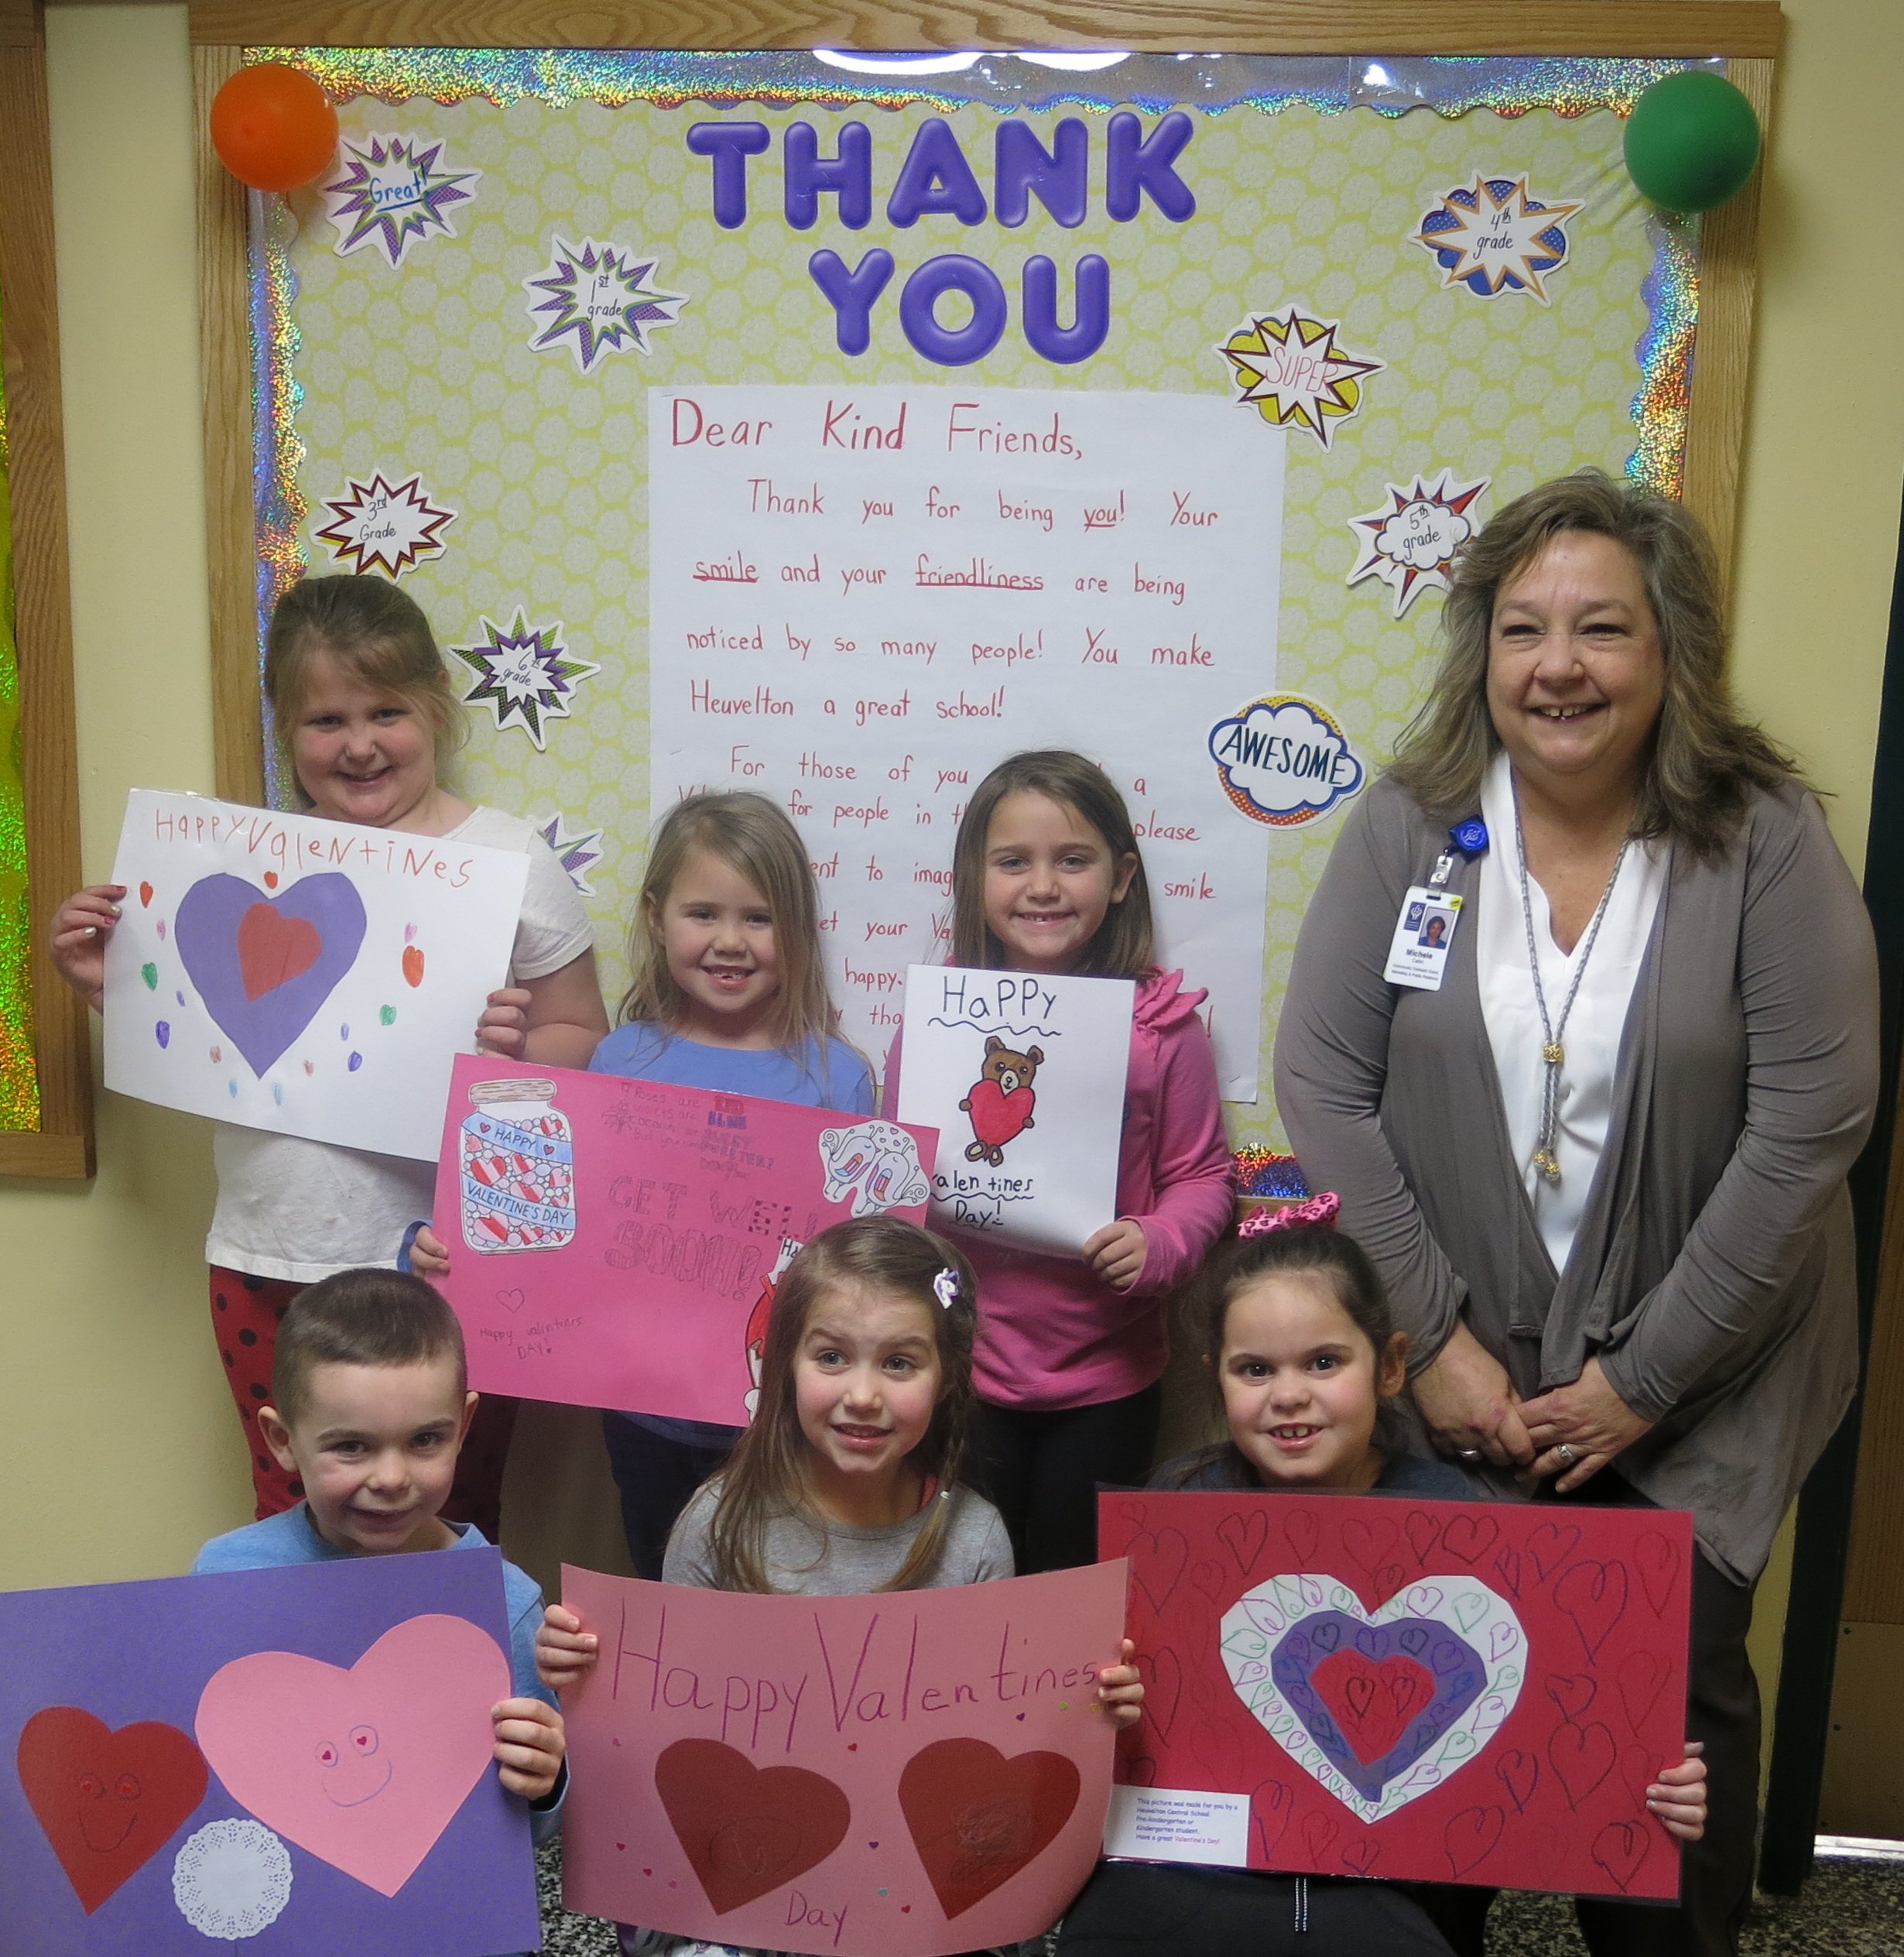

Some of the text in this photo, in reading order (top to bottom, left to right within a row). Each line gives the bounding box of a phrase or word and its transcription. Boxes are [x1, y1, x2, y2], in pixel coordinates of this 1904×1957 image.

[369, 163, 427, 204] Great!
[686, 111, 1197, 230] THANK
[1491, 207, 1512, 231] 4th
[1473, 235, 1514, 260] grade
[587, 298, 623, 321] grade
[808, 248, 1109, 366] YOU
[1265, 346, 1339, 396] SUPER
[671, 398, 1084, 460] Dear Kind Friends,
[368, 493, 388, 522] 3rd
[748, 478, 1218, 532] Thank you for being you! Your
[1409, 505, 1430, 530] 5th
[360, 524, 396, 542] Grade
[1402, 529, 1441, 560] grade
[693, 550, 1185, 604] smile and your friendliness are being
[687, 624, 1216, 667] noticed by so many people! You make
[500, 667, 531, 687] grade
[690, 680, 1005, 725] Heuvelton a great school!
[731, 745, 1146, 796] For those of you a
[1219, 725, 1346, 785] AWESOME
[787, 789, 813, 817] for
[834, 795, 890, 828] people
[916, 804, 931, 824] in
[1133, 810, 1201, 841] please
[865, 855, 883, 881] to
[1164, 872, 1216, 900] smile
[865, 922, 908, 942] your
[844, 957, 902, 992] happy.
[1406, 949, 1433, 959] Michele
[495, 1128, 536, 1150] HAPPY
[609, 1176, 687, 1221] GET
[931, 1170, 1034, 1193] alentines
[468, 1182, 570, 1225] VALENTINE'S DAY
[955, 1201, 1003, 1223] Day!
[613, 1598, 1096, 1753] Happy Valentines
[785, 1890, 848, 1947] Day
